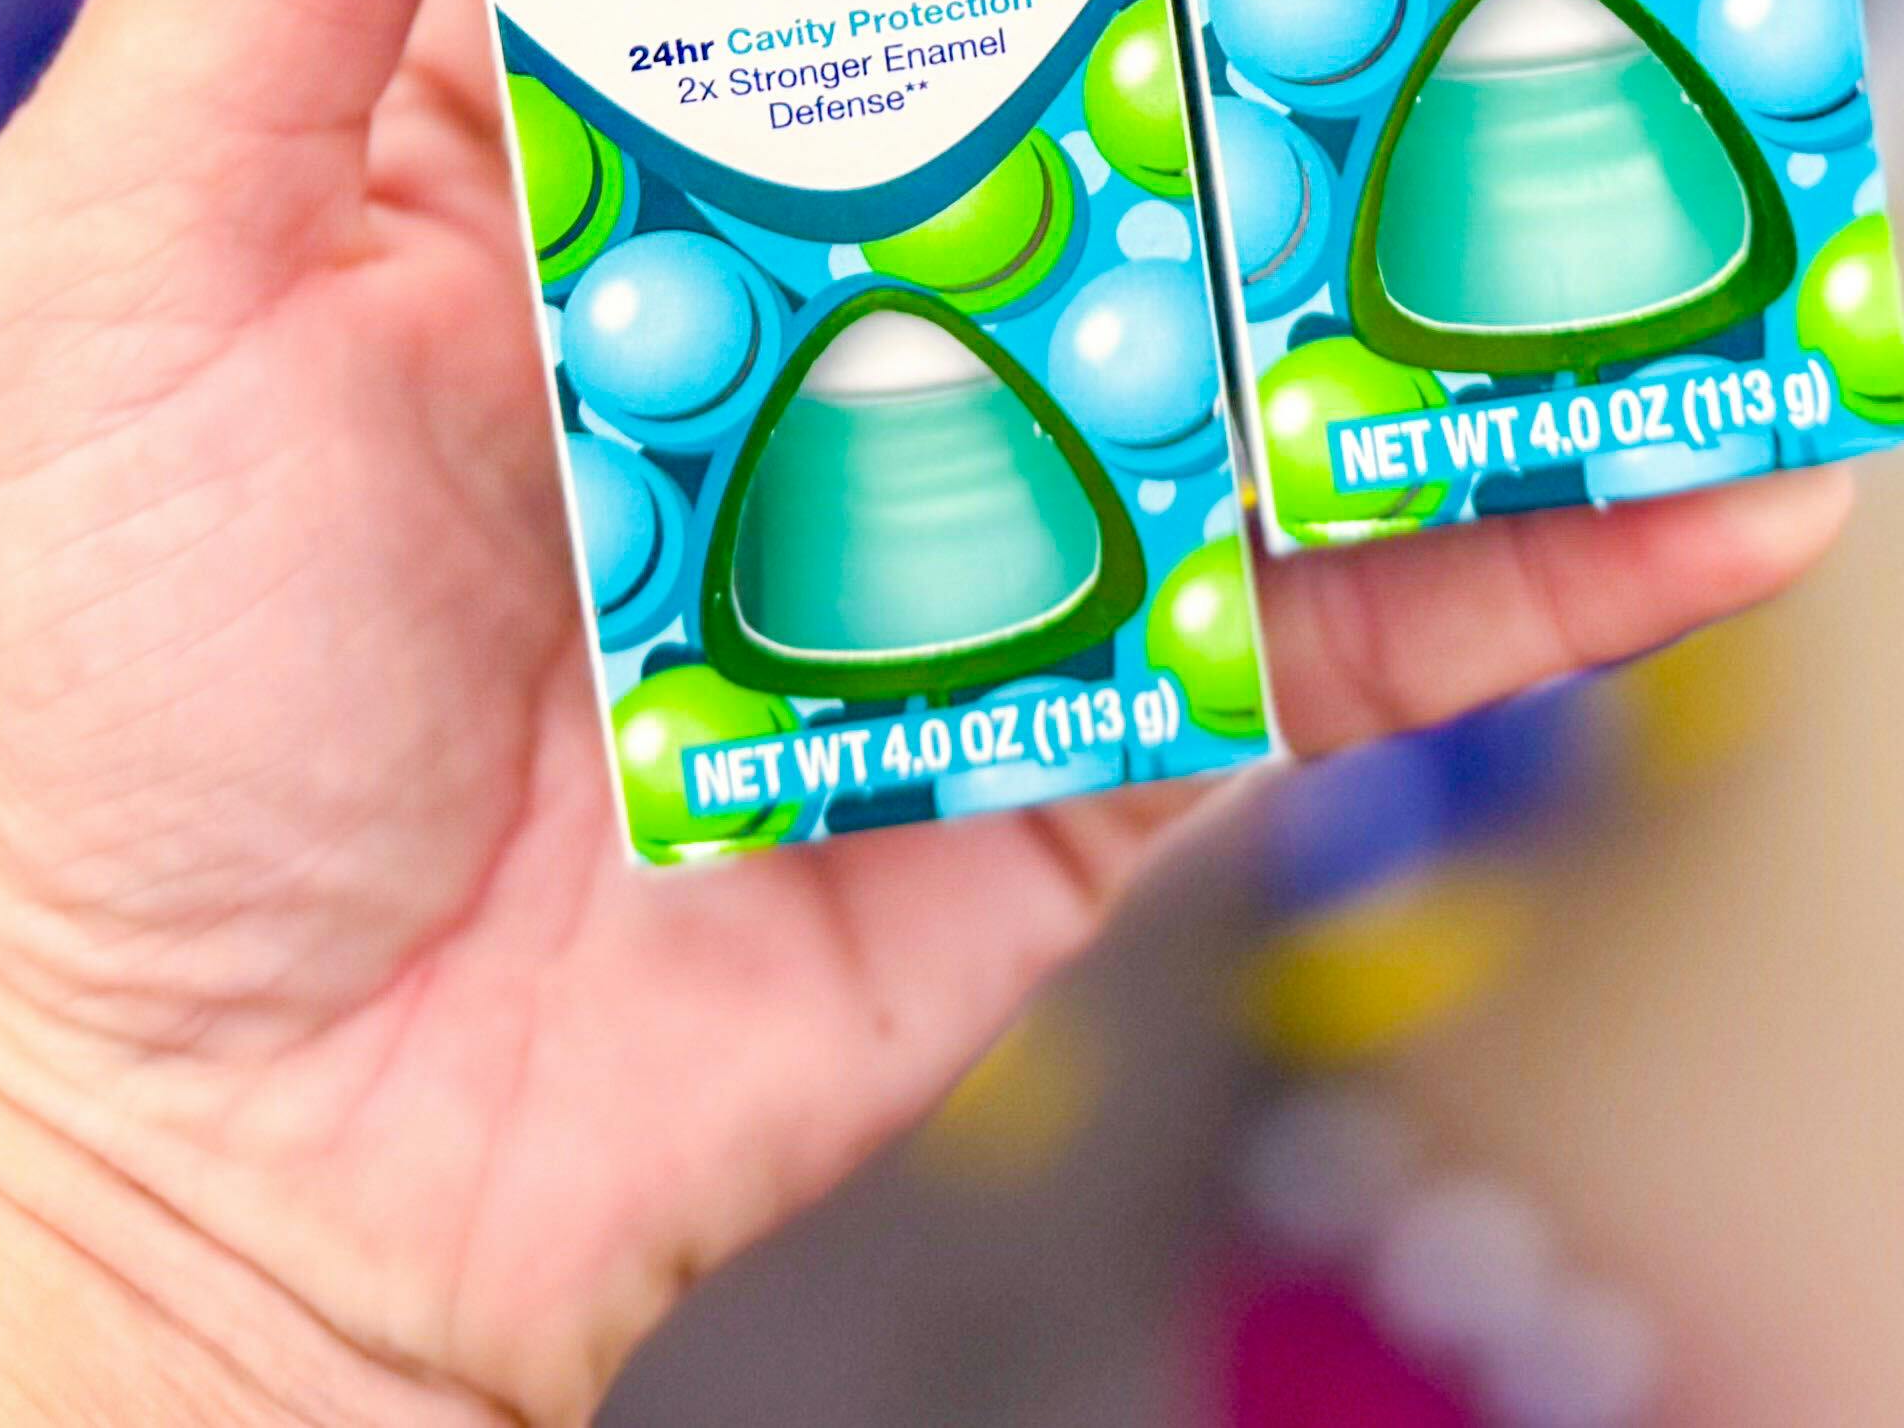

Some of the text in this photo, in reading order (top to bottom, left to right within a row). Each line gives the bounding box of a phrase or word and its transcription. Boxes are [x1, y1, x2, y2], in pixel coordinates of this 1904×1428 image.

[629, 35, 716, 72] 24hr
[727, 17, 837, 56] Cavity
[678, 29, 1008, 105] 2x Stronger Enamel
[1338, 358, 1832, 485] NET WT 4.0 OZ (113 g)
[693, 677, 1181, 808] NET WT 4.0 OZ (113 g)
